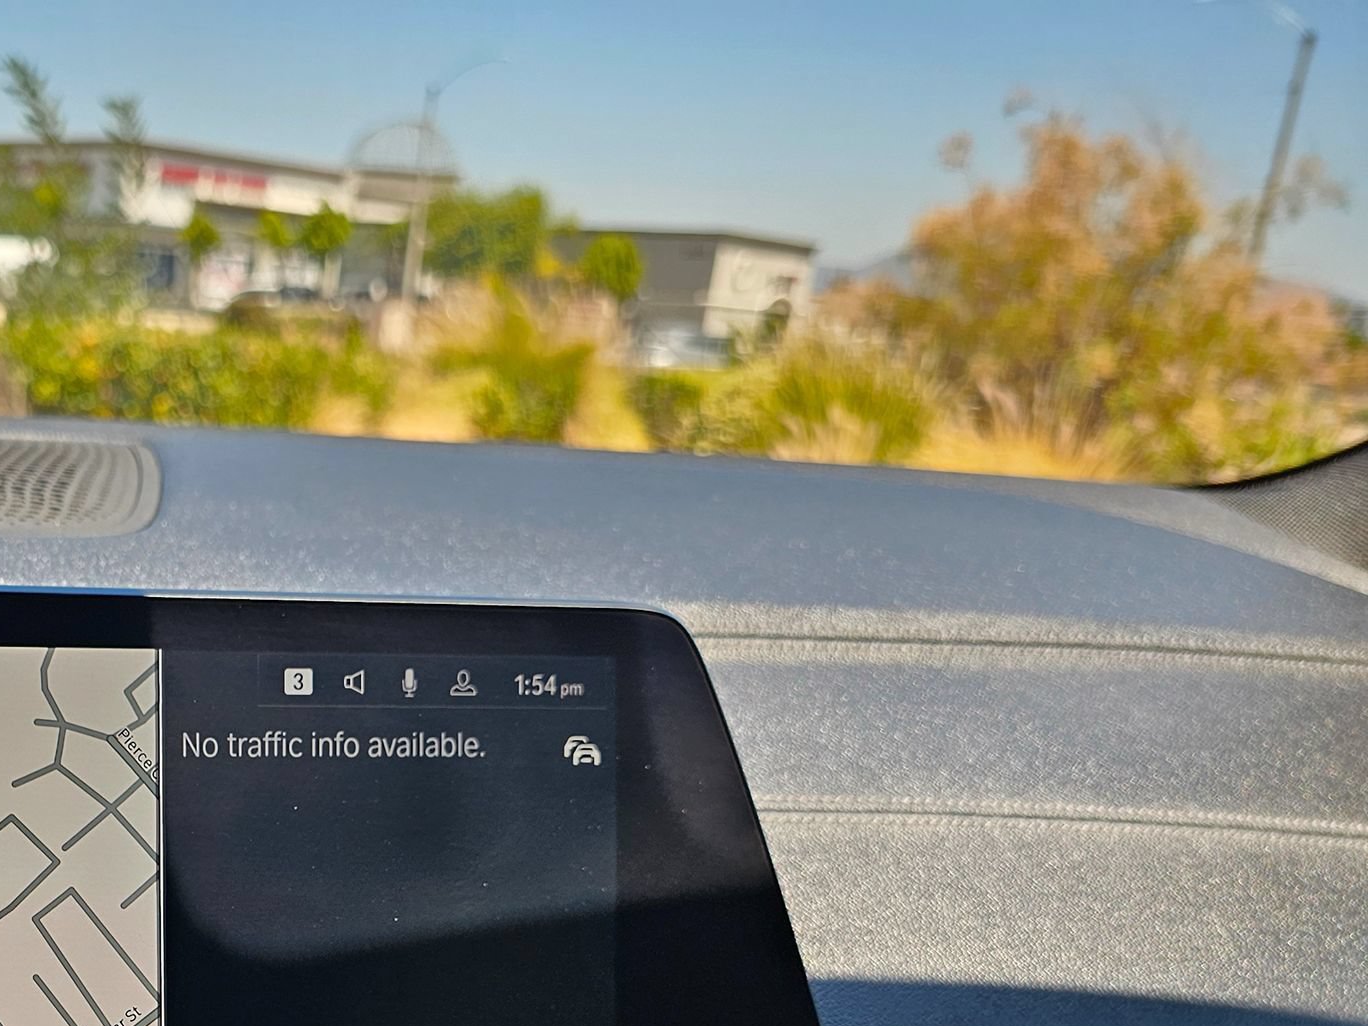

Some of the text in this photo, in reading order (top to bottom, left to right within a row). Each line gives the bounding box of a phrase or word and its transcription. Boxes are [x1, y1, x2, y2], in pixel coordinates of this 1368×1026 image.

[293, 673, 304, 690] 3
[514, 674, 583, 698] 1:54 pm
[118, 728, 153, 769] Pierce
[182, 730, 486, 758] No traffic info available.
[125, 1006, 142, 1022] St
